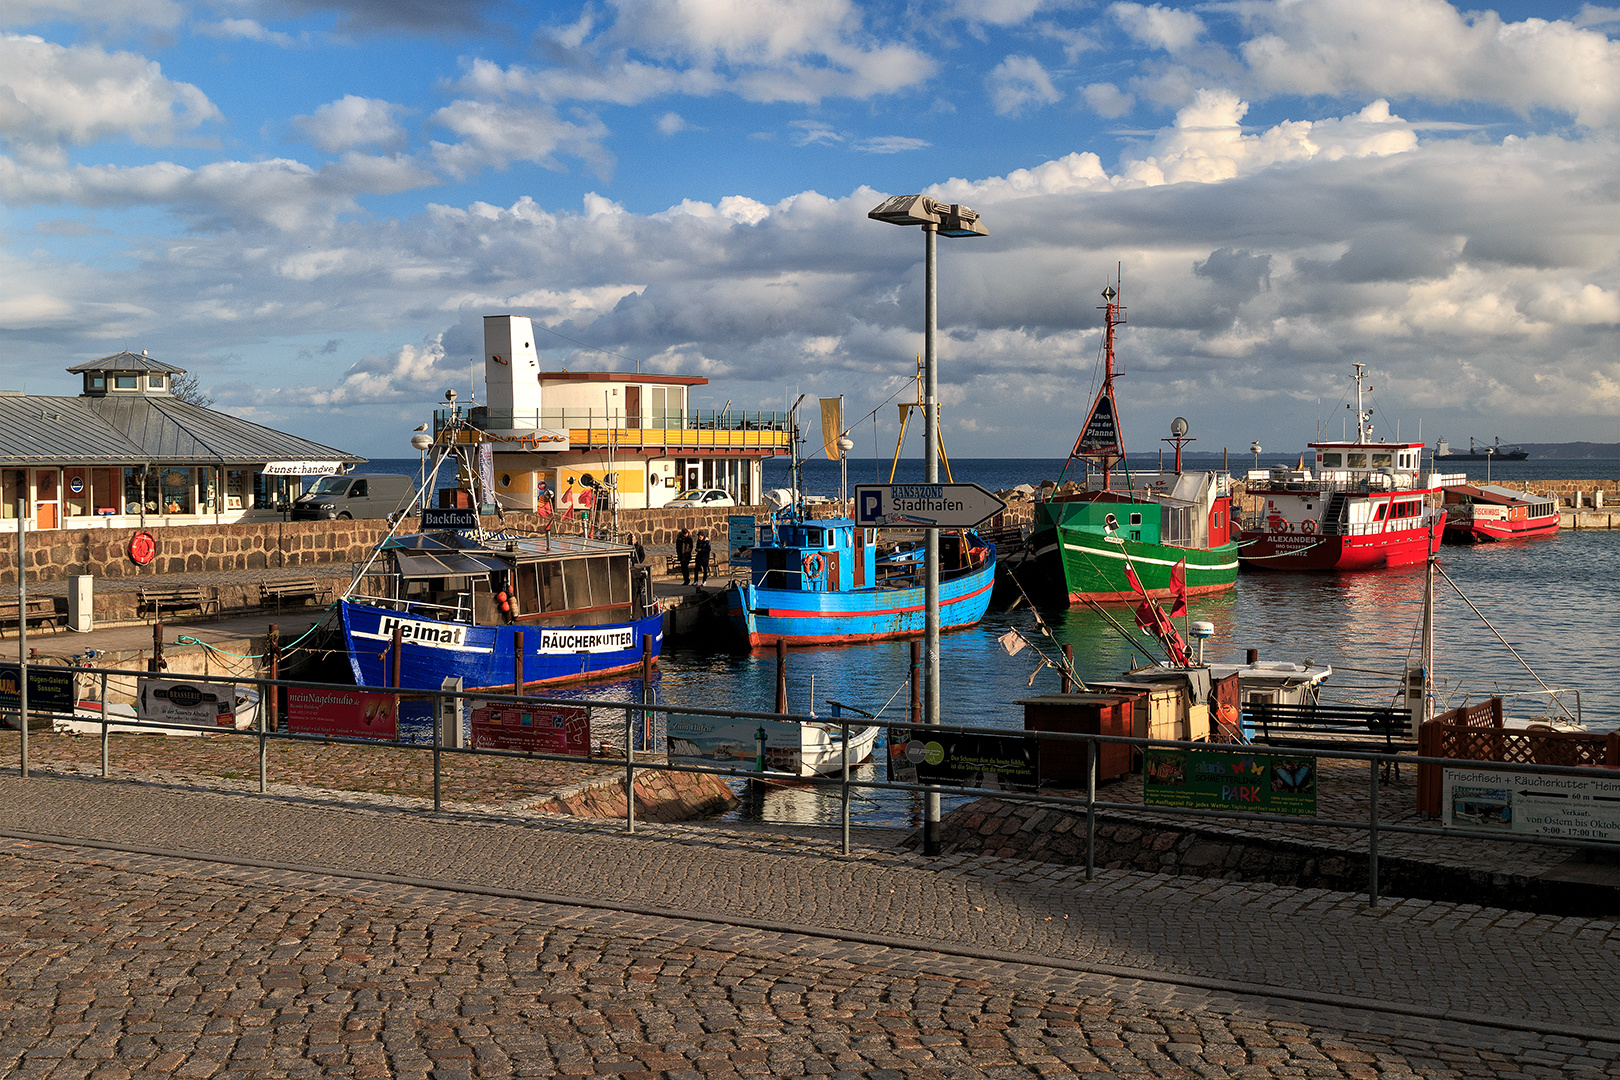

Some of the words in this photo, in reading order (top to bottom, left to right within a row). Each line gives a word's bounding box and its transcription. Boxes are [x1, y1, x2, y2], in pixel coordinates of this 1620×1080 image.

[1086, 428, 1114, 436] Pfanne
[892, 486, 943, 498] HANSAZONE
[892, 498, 963, 511] Stadthafen
[425, 513, 472, 525] Backfisch
[1266, 535, 1317, 544] ALEXANDER
[383, 617, 463, 645] Heimat
[542, 632, 632, 649] RÄUCHERKUTTER
[29, 674, 69, 685] Rügen-Galerie
[37, 684, 61, 693] Sassnitz
[169, 690, 201, 700] BRASSERIE
[289, 692, 353, 708] meinNagelstudio
[1194, 774, 1263, 785] SCHMETTERLINGS
[1447, 771, 1502, 784] Frischfisch
[1514, 775, 1588, 790] Räucherkutter
[1221, 784, 1261, 803] PARK
[1155, 799, 1184, 807] Ausflugsziel
[1231, 803, 1247, 811] Täglich
[1247, 805, 1268, 813] geöffnet
[1544, 816, 1573, 827] Ostern
[1575, 818, 1588, 828] bis
[1543, 826, 1561, 835] 9:00
[1568, 827, 1590, 837] 17:00
[1592, 830, 1610, 838] Uhr
